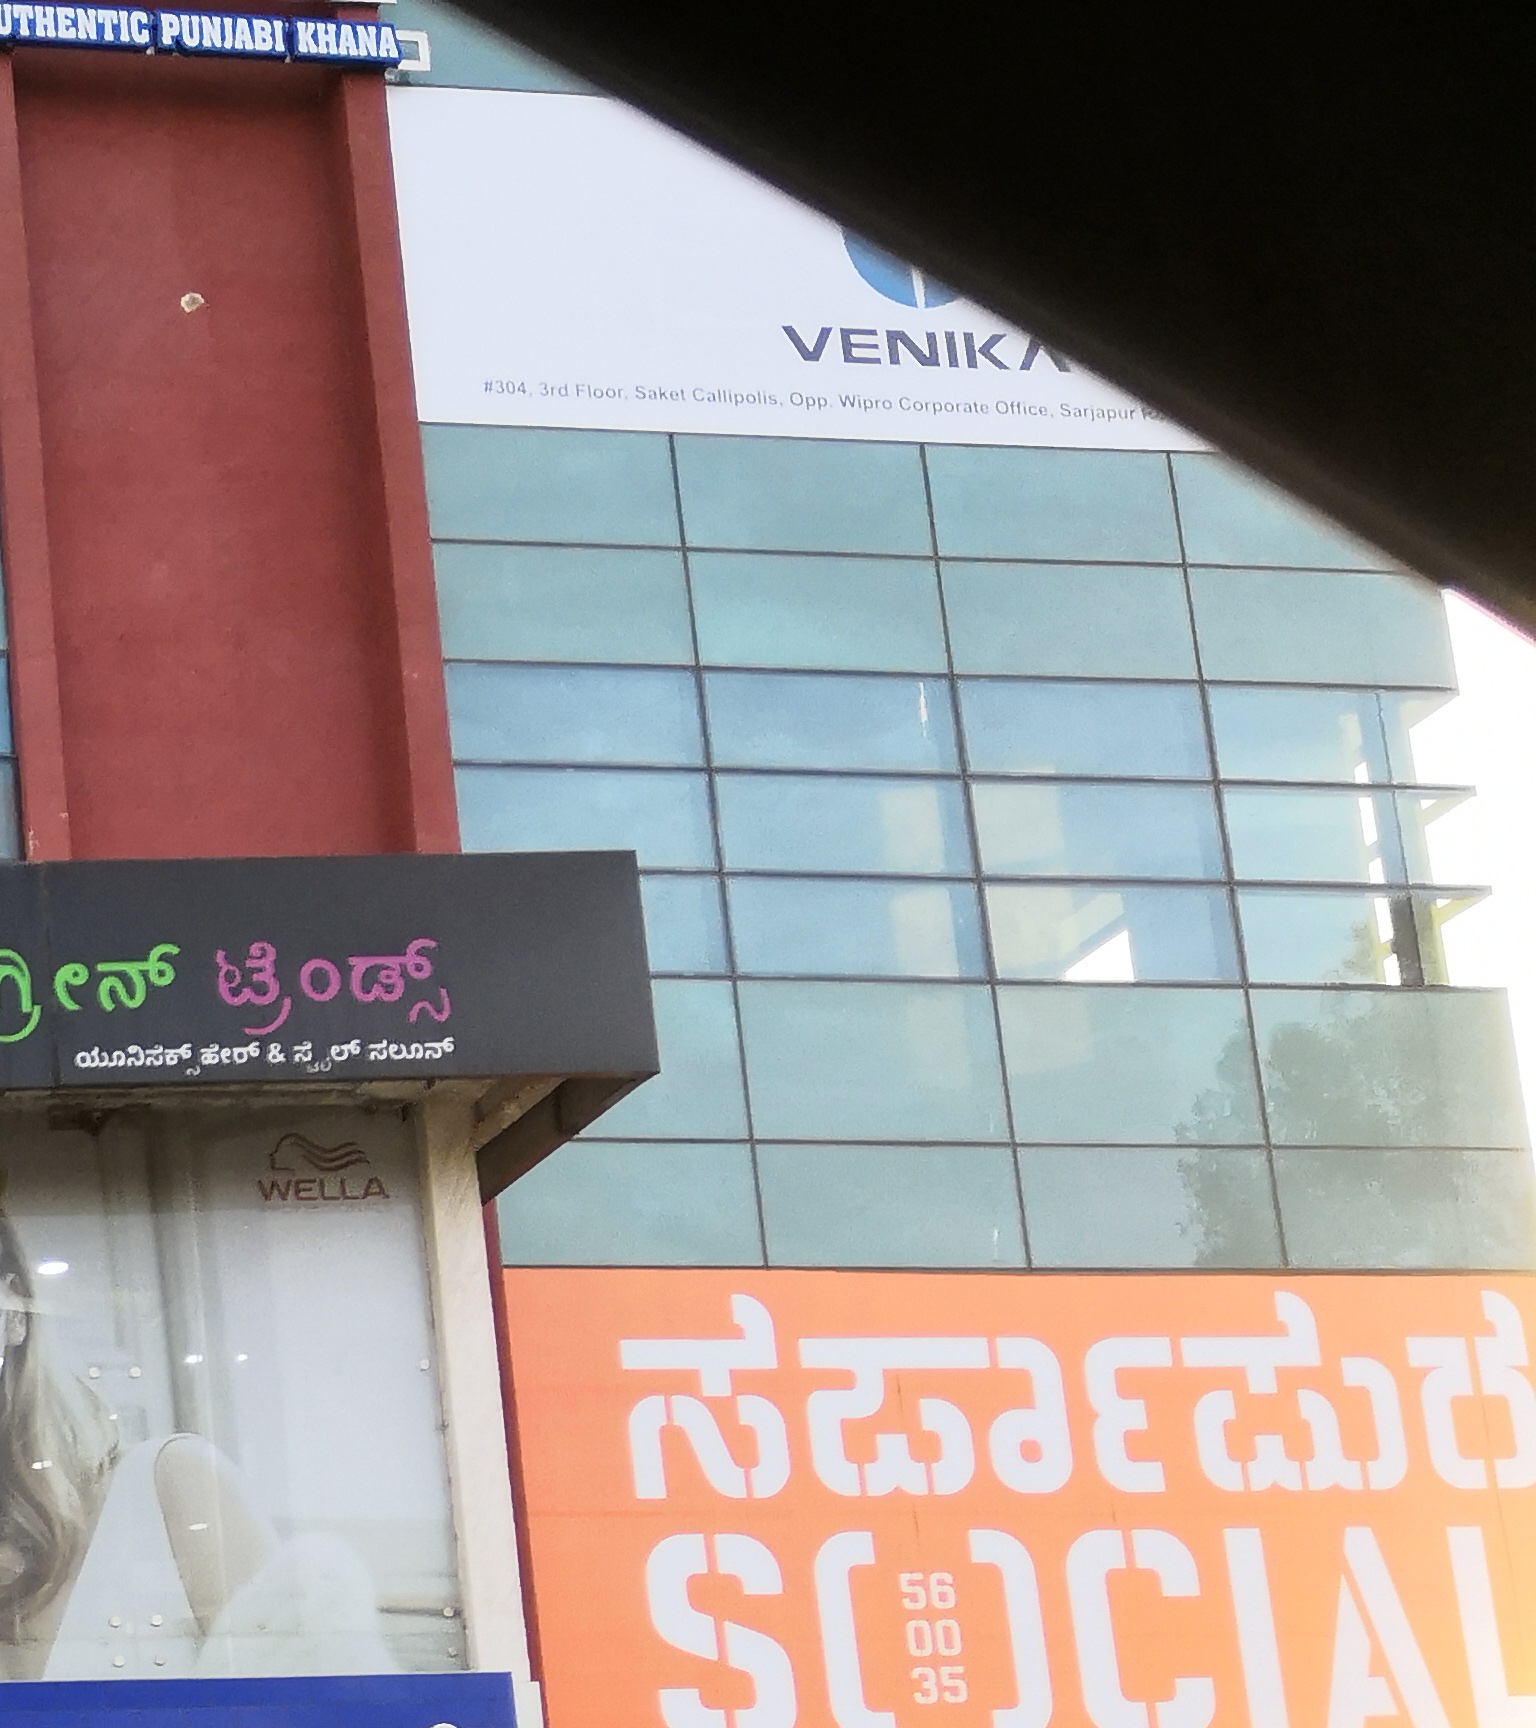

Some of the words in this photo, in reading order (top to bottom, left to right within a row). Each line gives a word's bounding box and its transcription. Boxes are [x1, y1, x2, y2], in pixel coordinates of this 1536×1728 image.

[161, 20, 287, 54] PUNJABI
[295, 22, 399, 58] KHANA
[482, 380, 534, 398] #304,
[539, 382, 569, 398] 3rd
[634, 385, 686, 402] Saket
[789, 391, 833, 411] Opp.
[838, 394, 893, 412] Wipro
[898, 397, 989, 418] Corporate
[1060, 403, 1135, 422] Sarjapur
[257, 1176, 388, 1202] WELLA
[897, 1570, 957, 1611] 56
[905, 1618, 963, 1658] 00
[911, 1665, 969, 1705] 35
